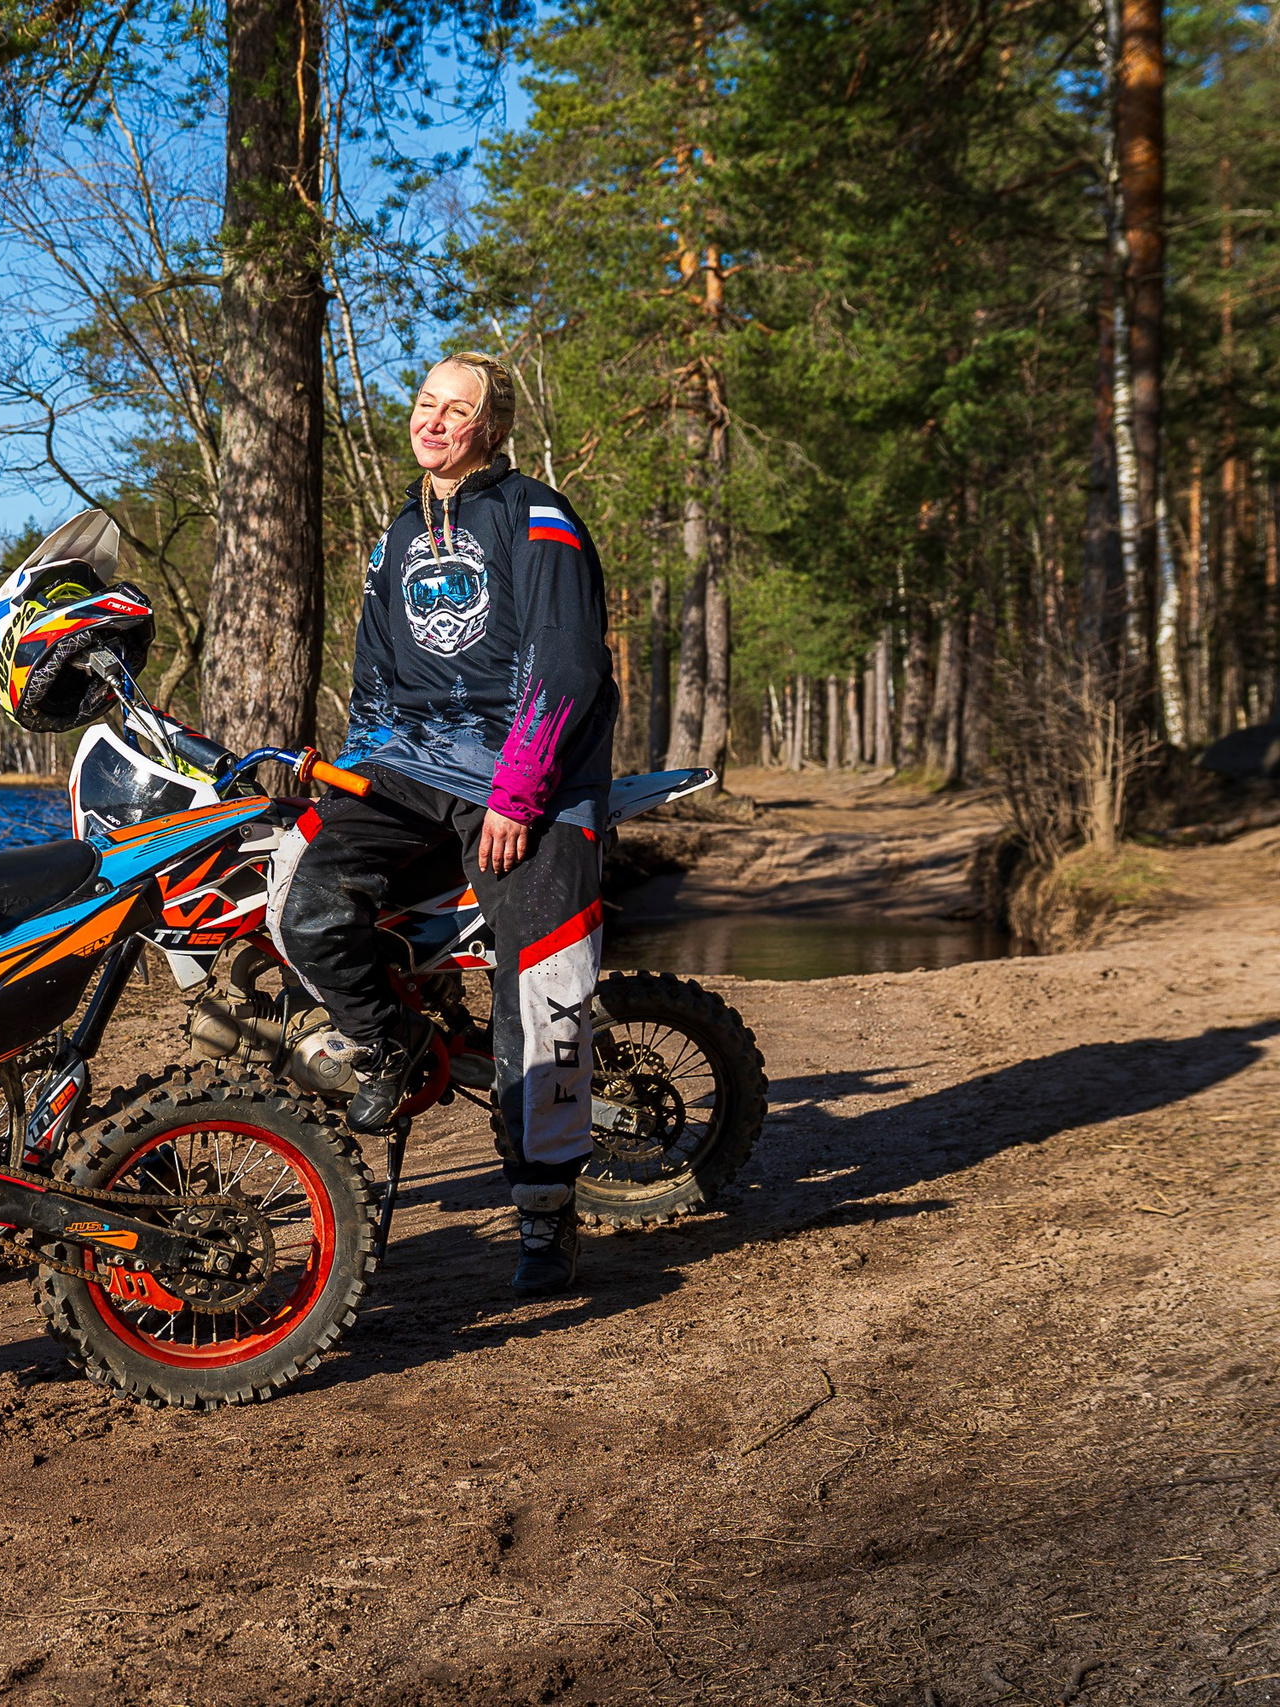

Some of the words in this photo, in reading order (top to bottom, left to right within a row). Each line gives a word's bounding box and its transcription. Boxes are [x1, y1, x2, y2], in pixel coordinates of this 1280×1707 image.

[154, 929, 190, 944] TT
[187, 932, 227, 945] 125
[546, 996, 582, 1104] FOX
[50, 1081, 77, 1116] 125
